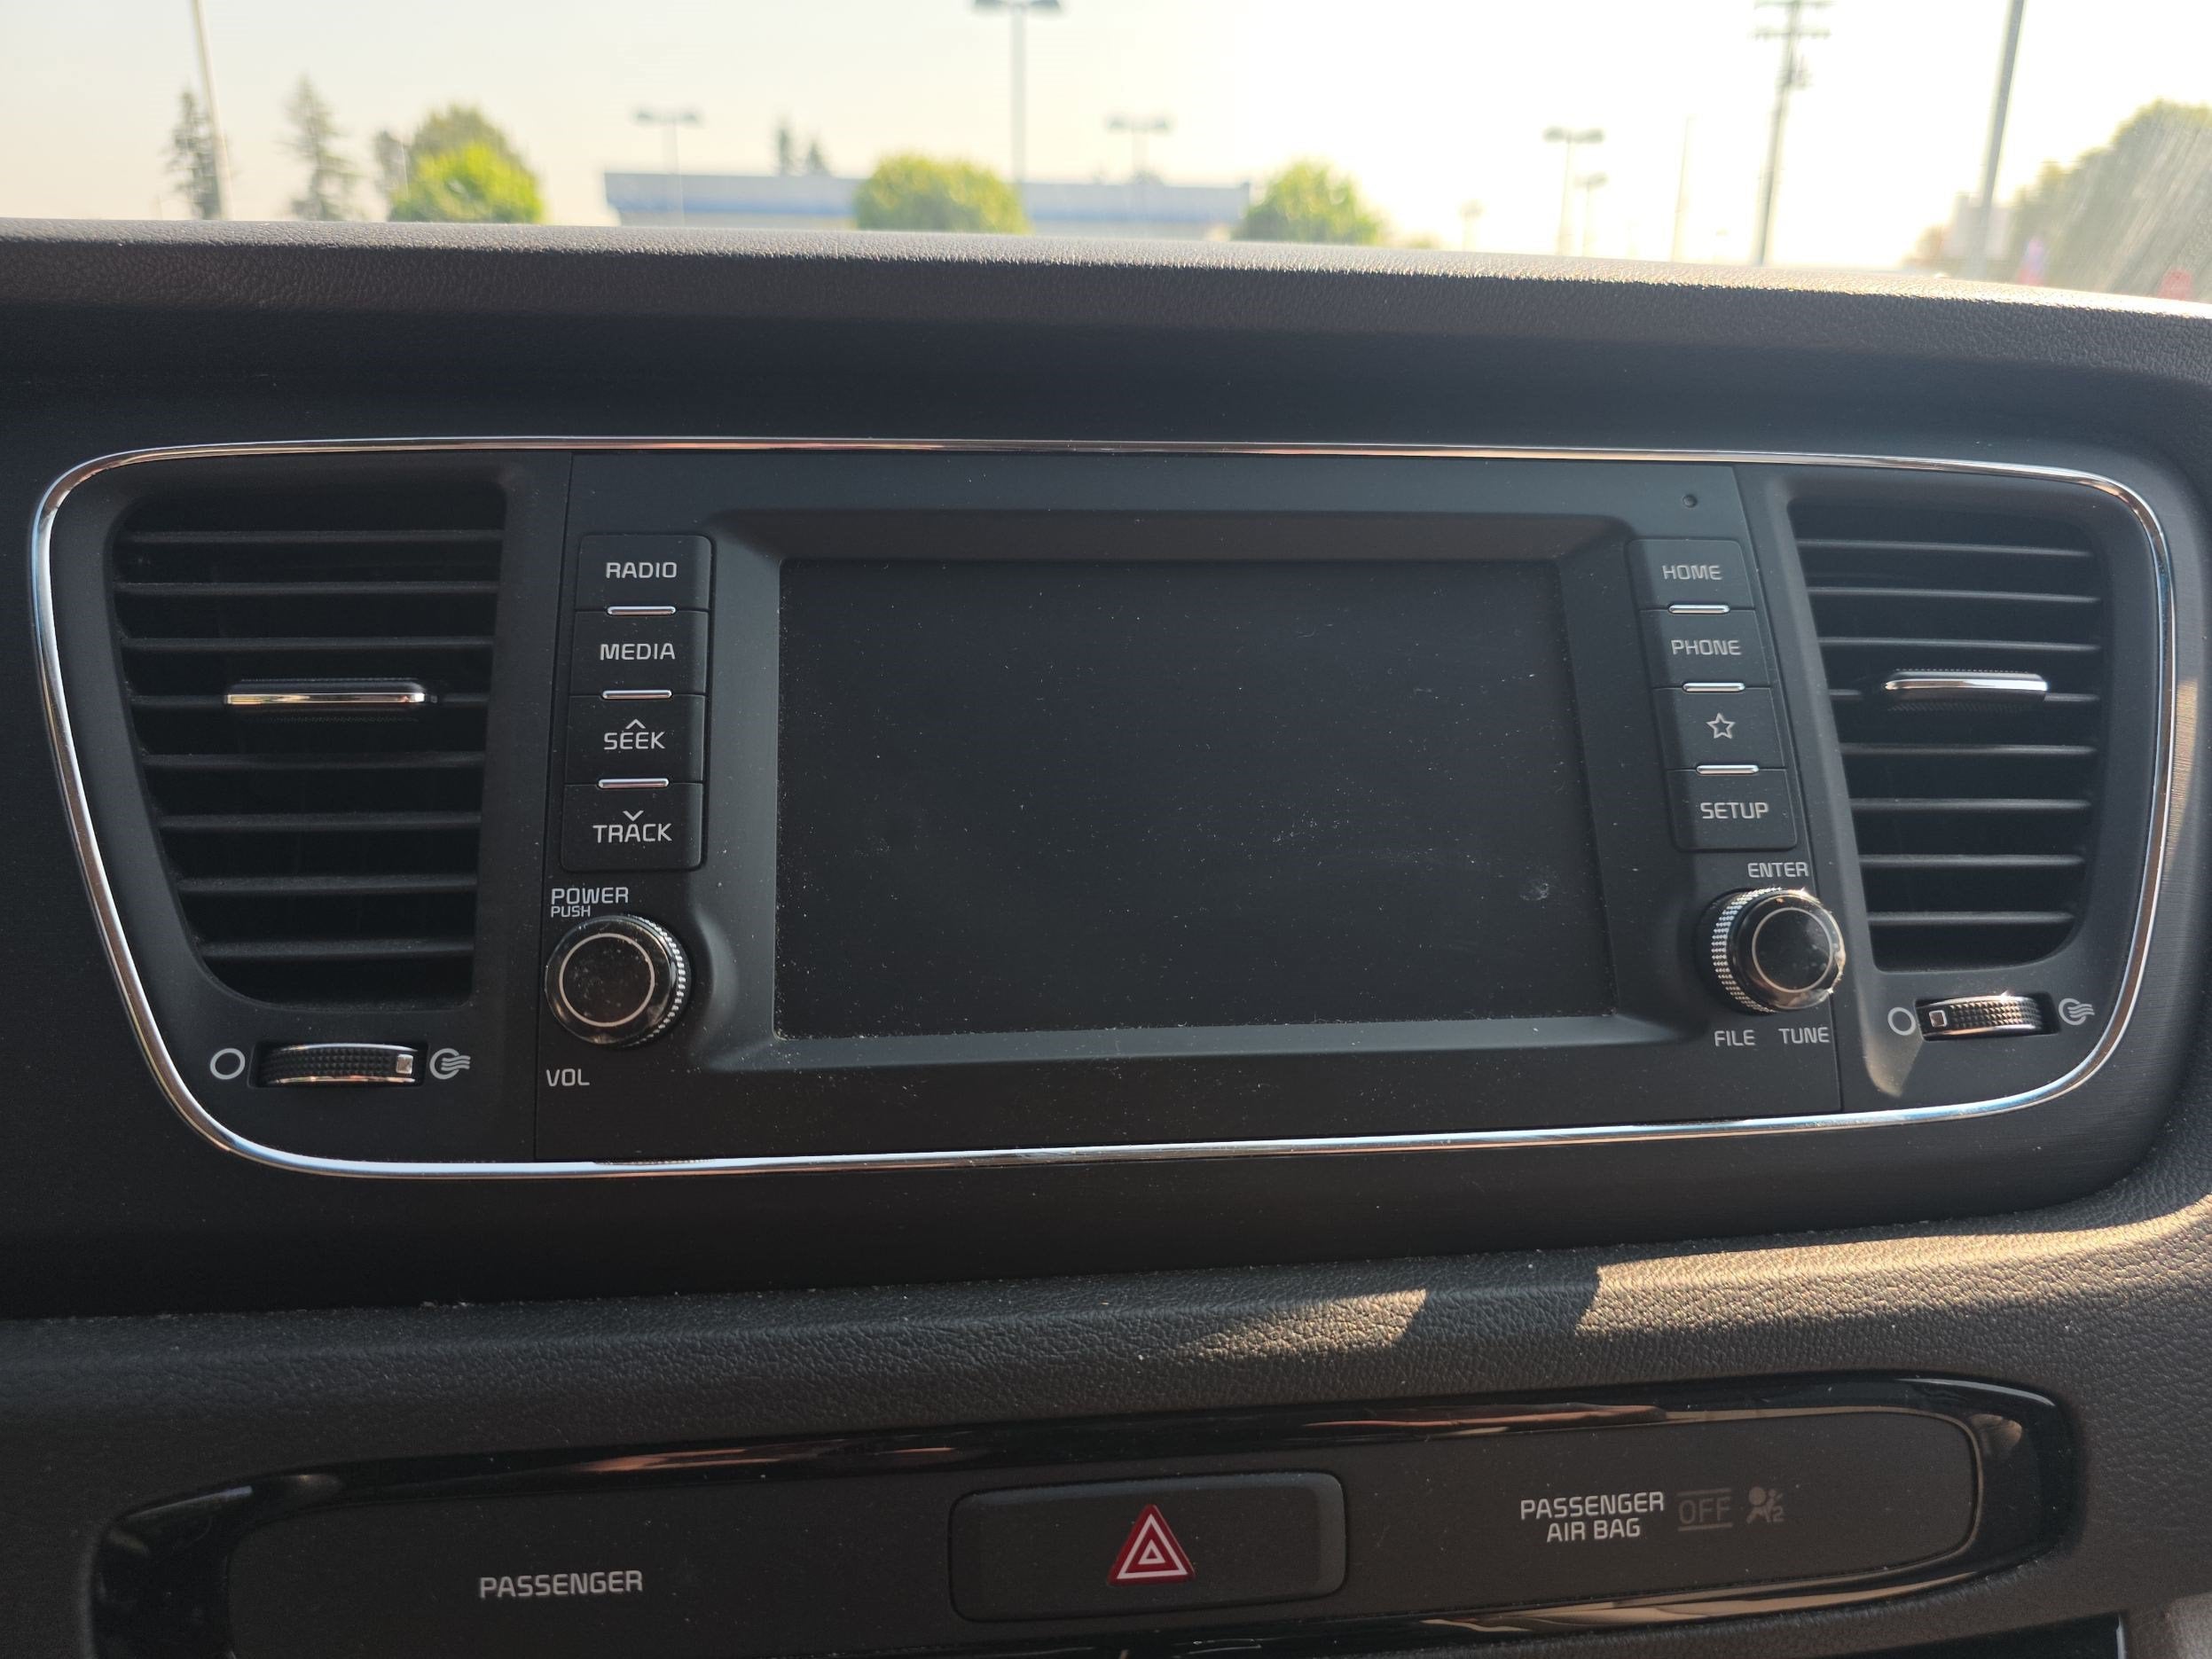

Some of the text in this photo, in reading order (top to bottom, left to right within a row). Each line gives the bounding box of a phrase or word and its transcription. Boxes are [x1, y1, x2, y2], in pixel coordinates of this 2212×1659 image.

[606, 561, 678, 579] RADIO
[1662, 564, 1722, 581] HOME
[600, 643, 676, 661] MEDIA
[1671, 638, 1741, 656] PHONE
[604, 732, 665, 751] SEEK
[1700, 801, 1769, 820] SETUP
[592, 823, 672, 843] TRACK
[1747, 862, 1809, 879] ENTER
[551, 887, 629, 904] POWER
[551, 905, 591, 918] PUSH
[1714, 1029, 1755, 1046] FILE
[1778, 1025, 1830, 1045] TUNE
[545, 1068, 591, 1086] VOL
[1520, 1491, 1664, 1520] PASSENGER
[1679, 1496, 1731, 1525] OFF
[1547, 1518, 1641, 1543] AIR BAG
[480, 1569, 643, 1599] PASSENGER
